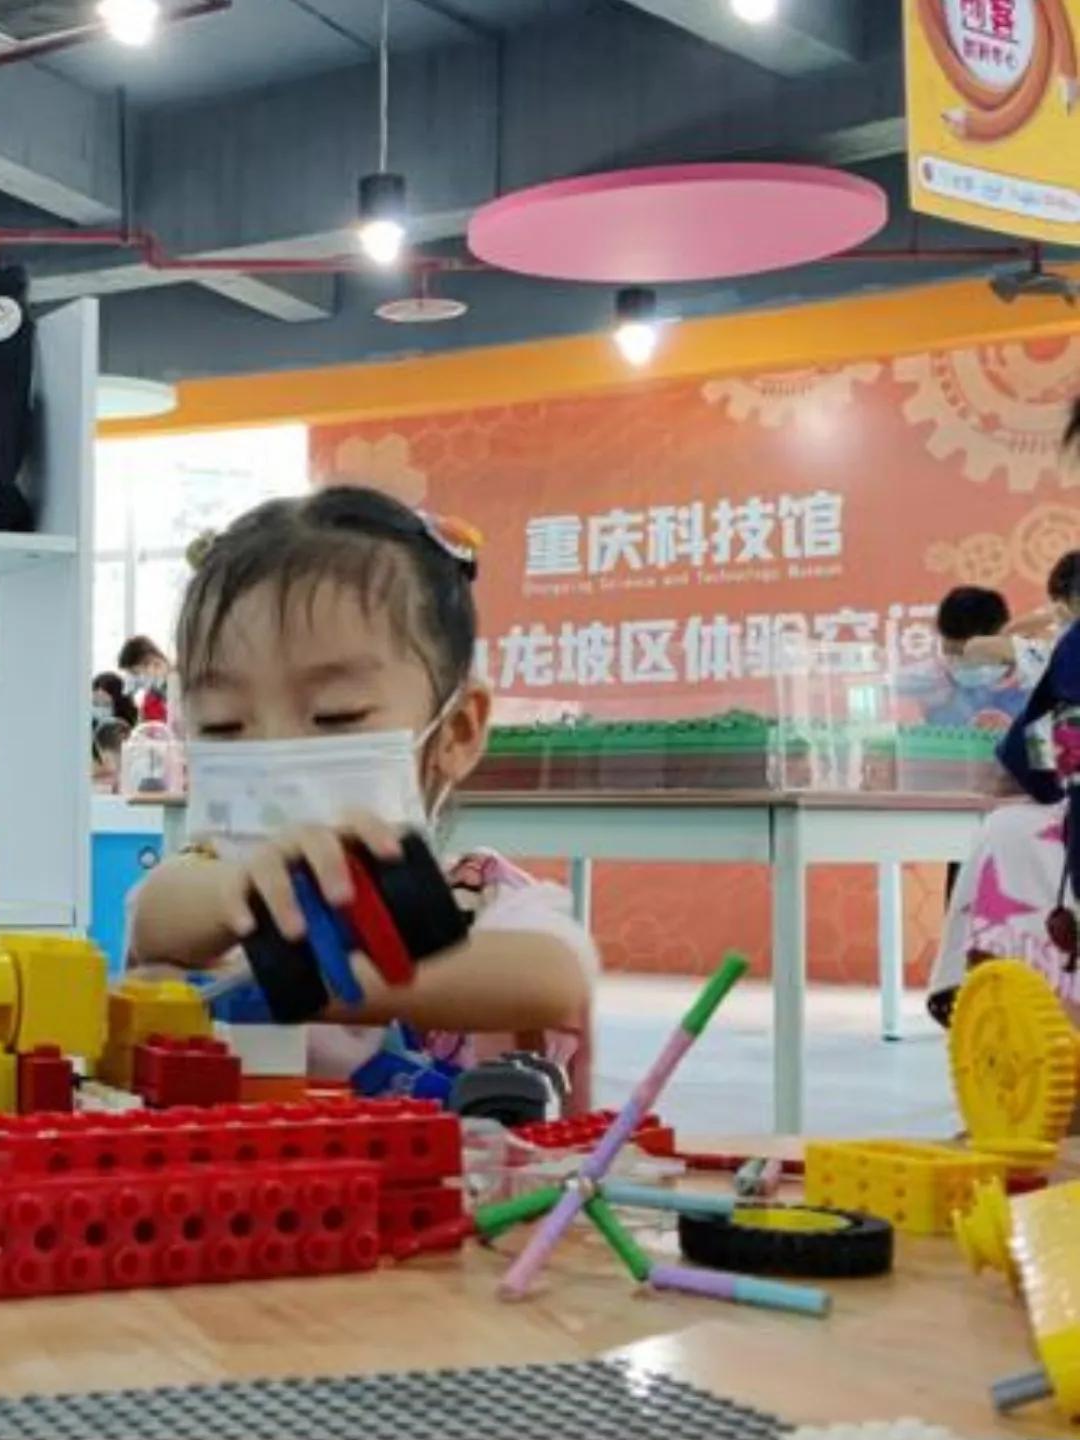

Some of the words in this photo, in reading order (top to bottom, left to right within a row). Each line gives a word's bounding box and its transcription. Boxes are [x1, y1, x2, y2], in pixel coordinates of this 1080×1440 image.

[525, 491, 843, 574] 重庆科技馆
